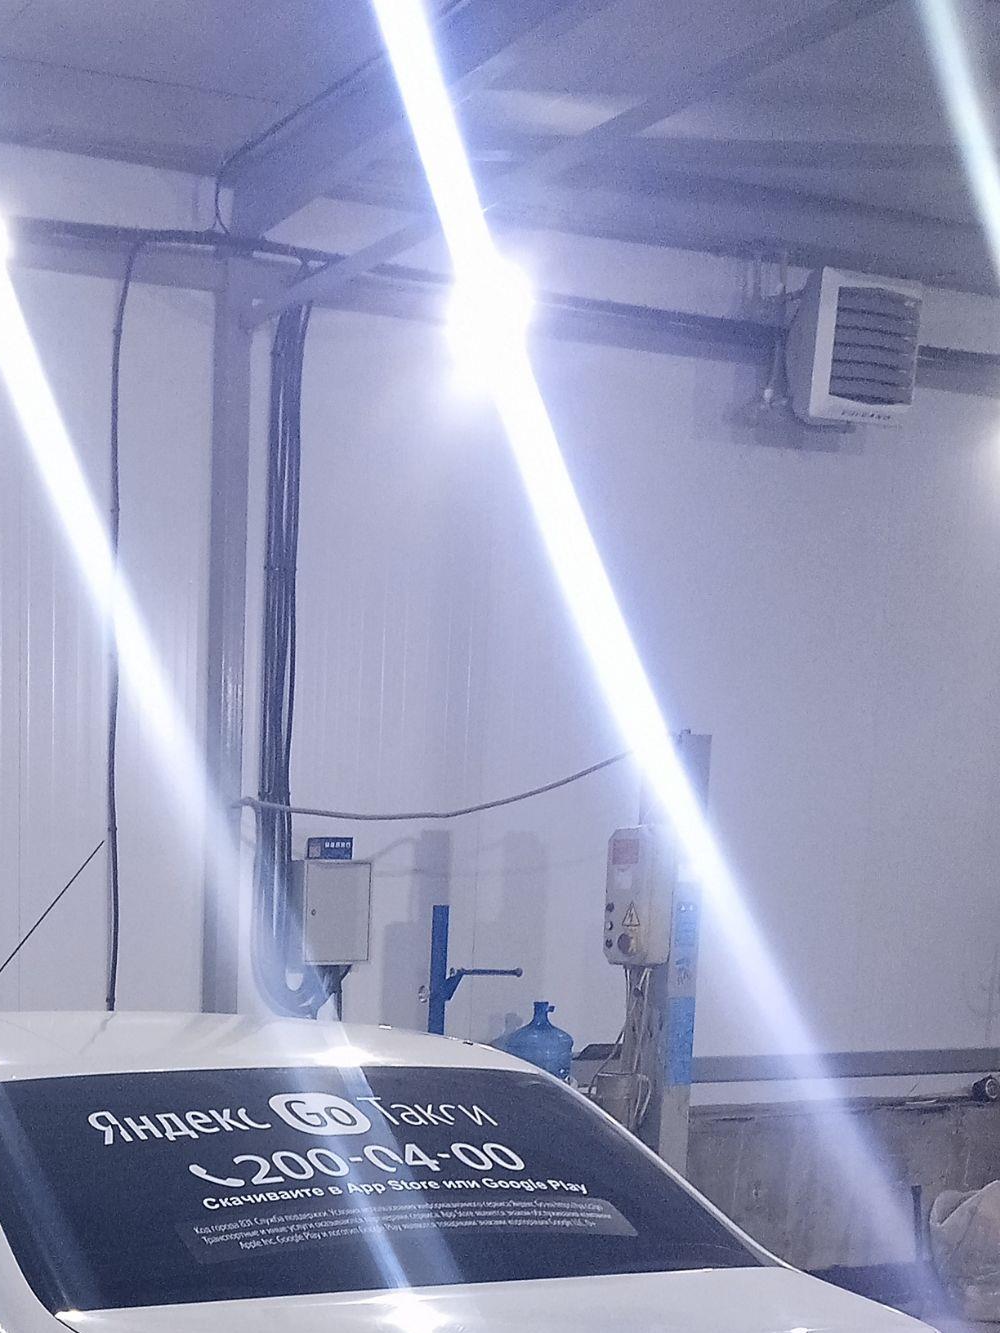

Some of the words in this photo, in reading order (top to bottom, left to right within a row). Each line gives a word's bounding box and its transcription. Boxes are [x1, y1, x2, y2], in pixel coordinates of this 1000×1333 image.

[88, 1107, 271, 1145] Яндекс
[282, 1098, 360, 1129] Go
[356, 1096, 498, 1127] Такси
[233, 1142, 525, 1185] 200-04-00
[327, 1186, 343, 1196] в
[347, 1181, 386, 1195] App
[387, 1179, 440, 1192] Store
[442, 1179, 481, 1190] или
[481, 1177, 548, 1192] Google
[548, 1178, 588, 1195] Play
